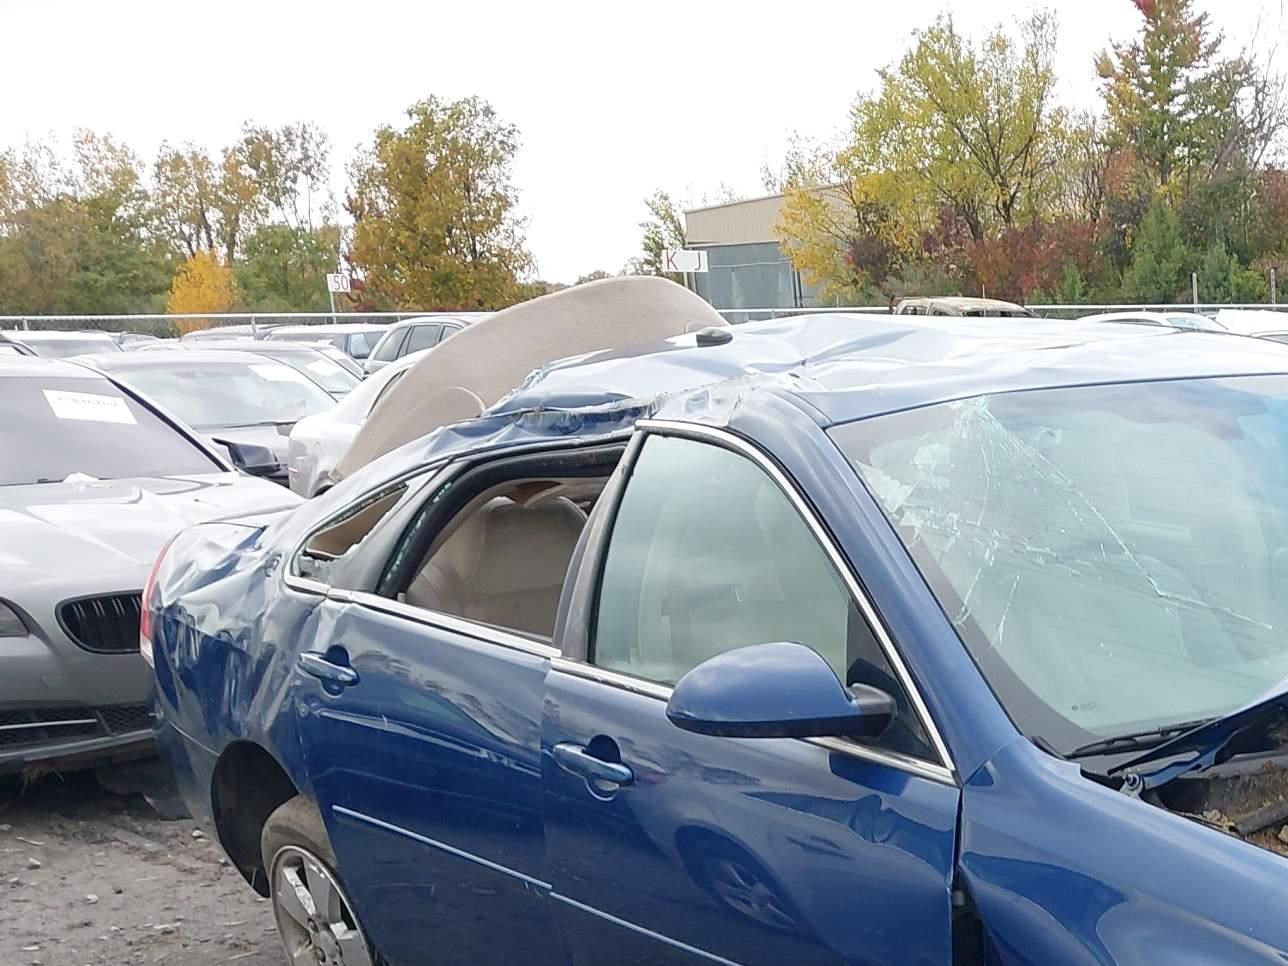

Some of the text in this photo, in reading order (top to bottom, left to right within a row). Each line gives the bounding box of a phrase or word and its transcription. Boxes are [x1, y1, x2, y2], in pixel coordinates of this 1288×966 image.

[666, 251, 701, 271] K J
[333, 274, 349, 291] 50
